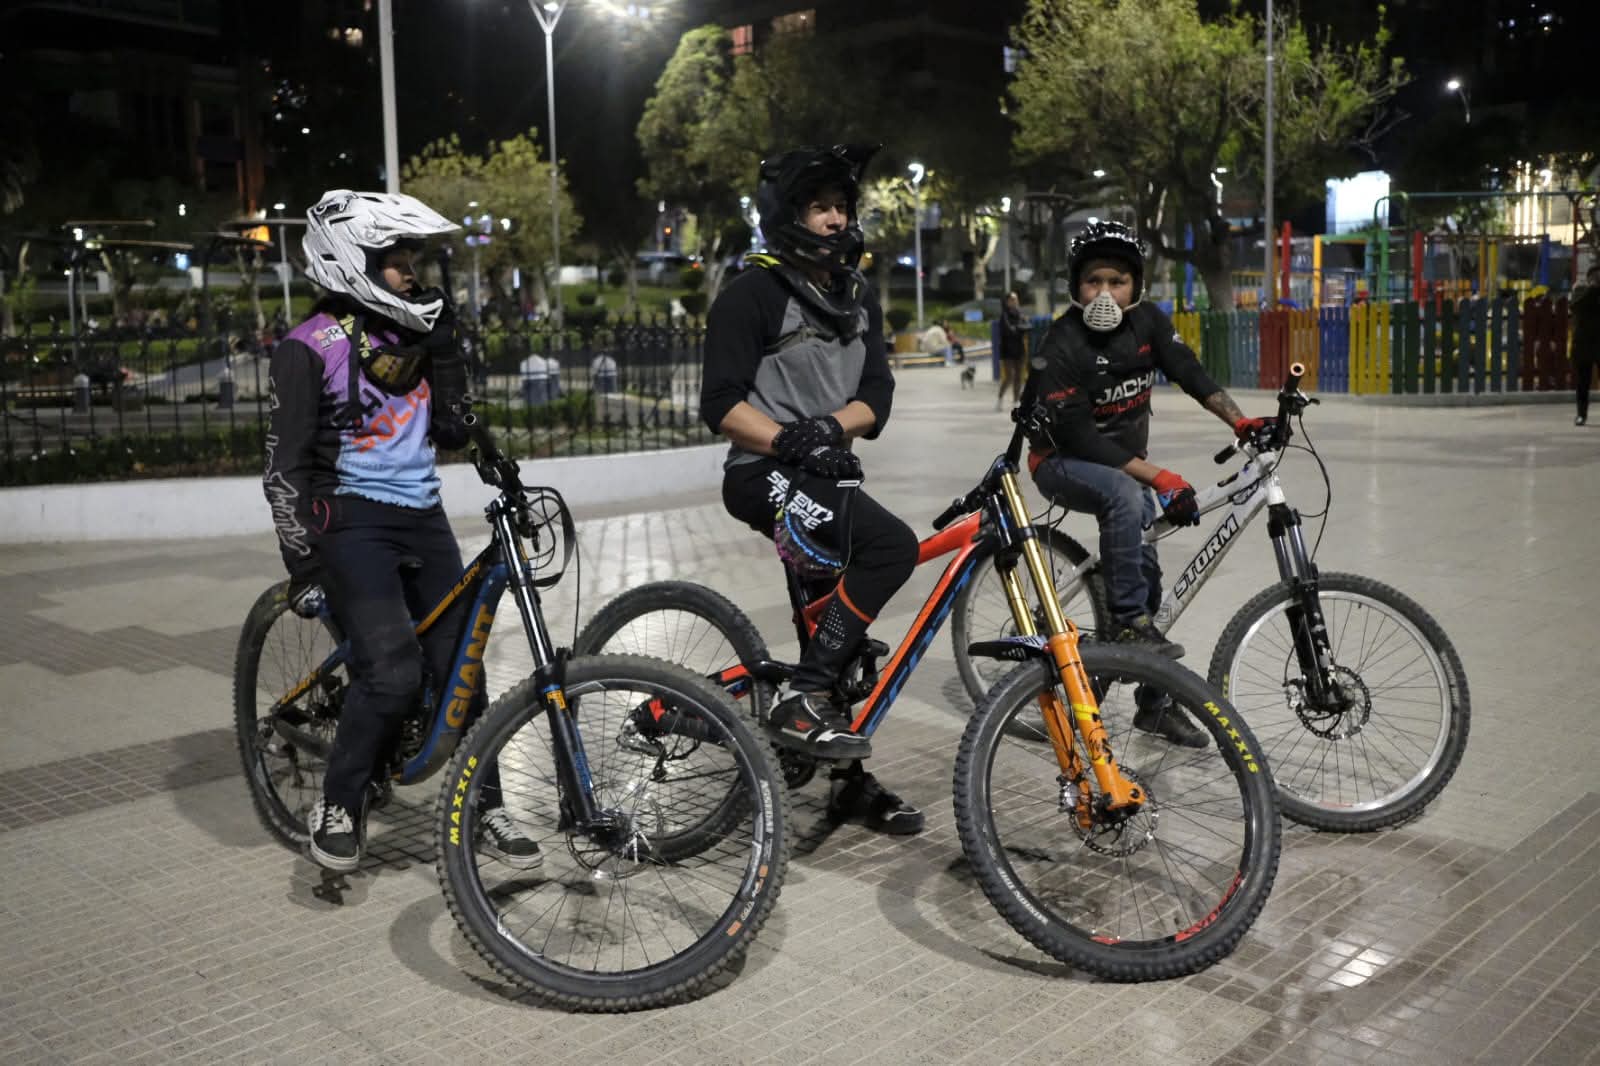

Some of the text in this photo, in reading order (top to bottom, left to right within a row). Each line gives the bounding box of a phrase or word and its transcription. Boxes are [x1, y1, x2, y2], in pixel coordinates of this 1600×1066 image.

[1174, 512, 1239, 599] STORM
[445, 603, 494, 729] GIANT
[1203, 701, 1259, 774] MAXXIS
[449, 755, 479, 847] MAXXIS
